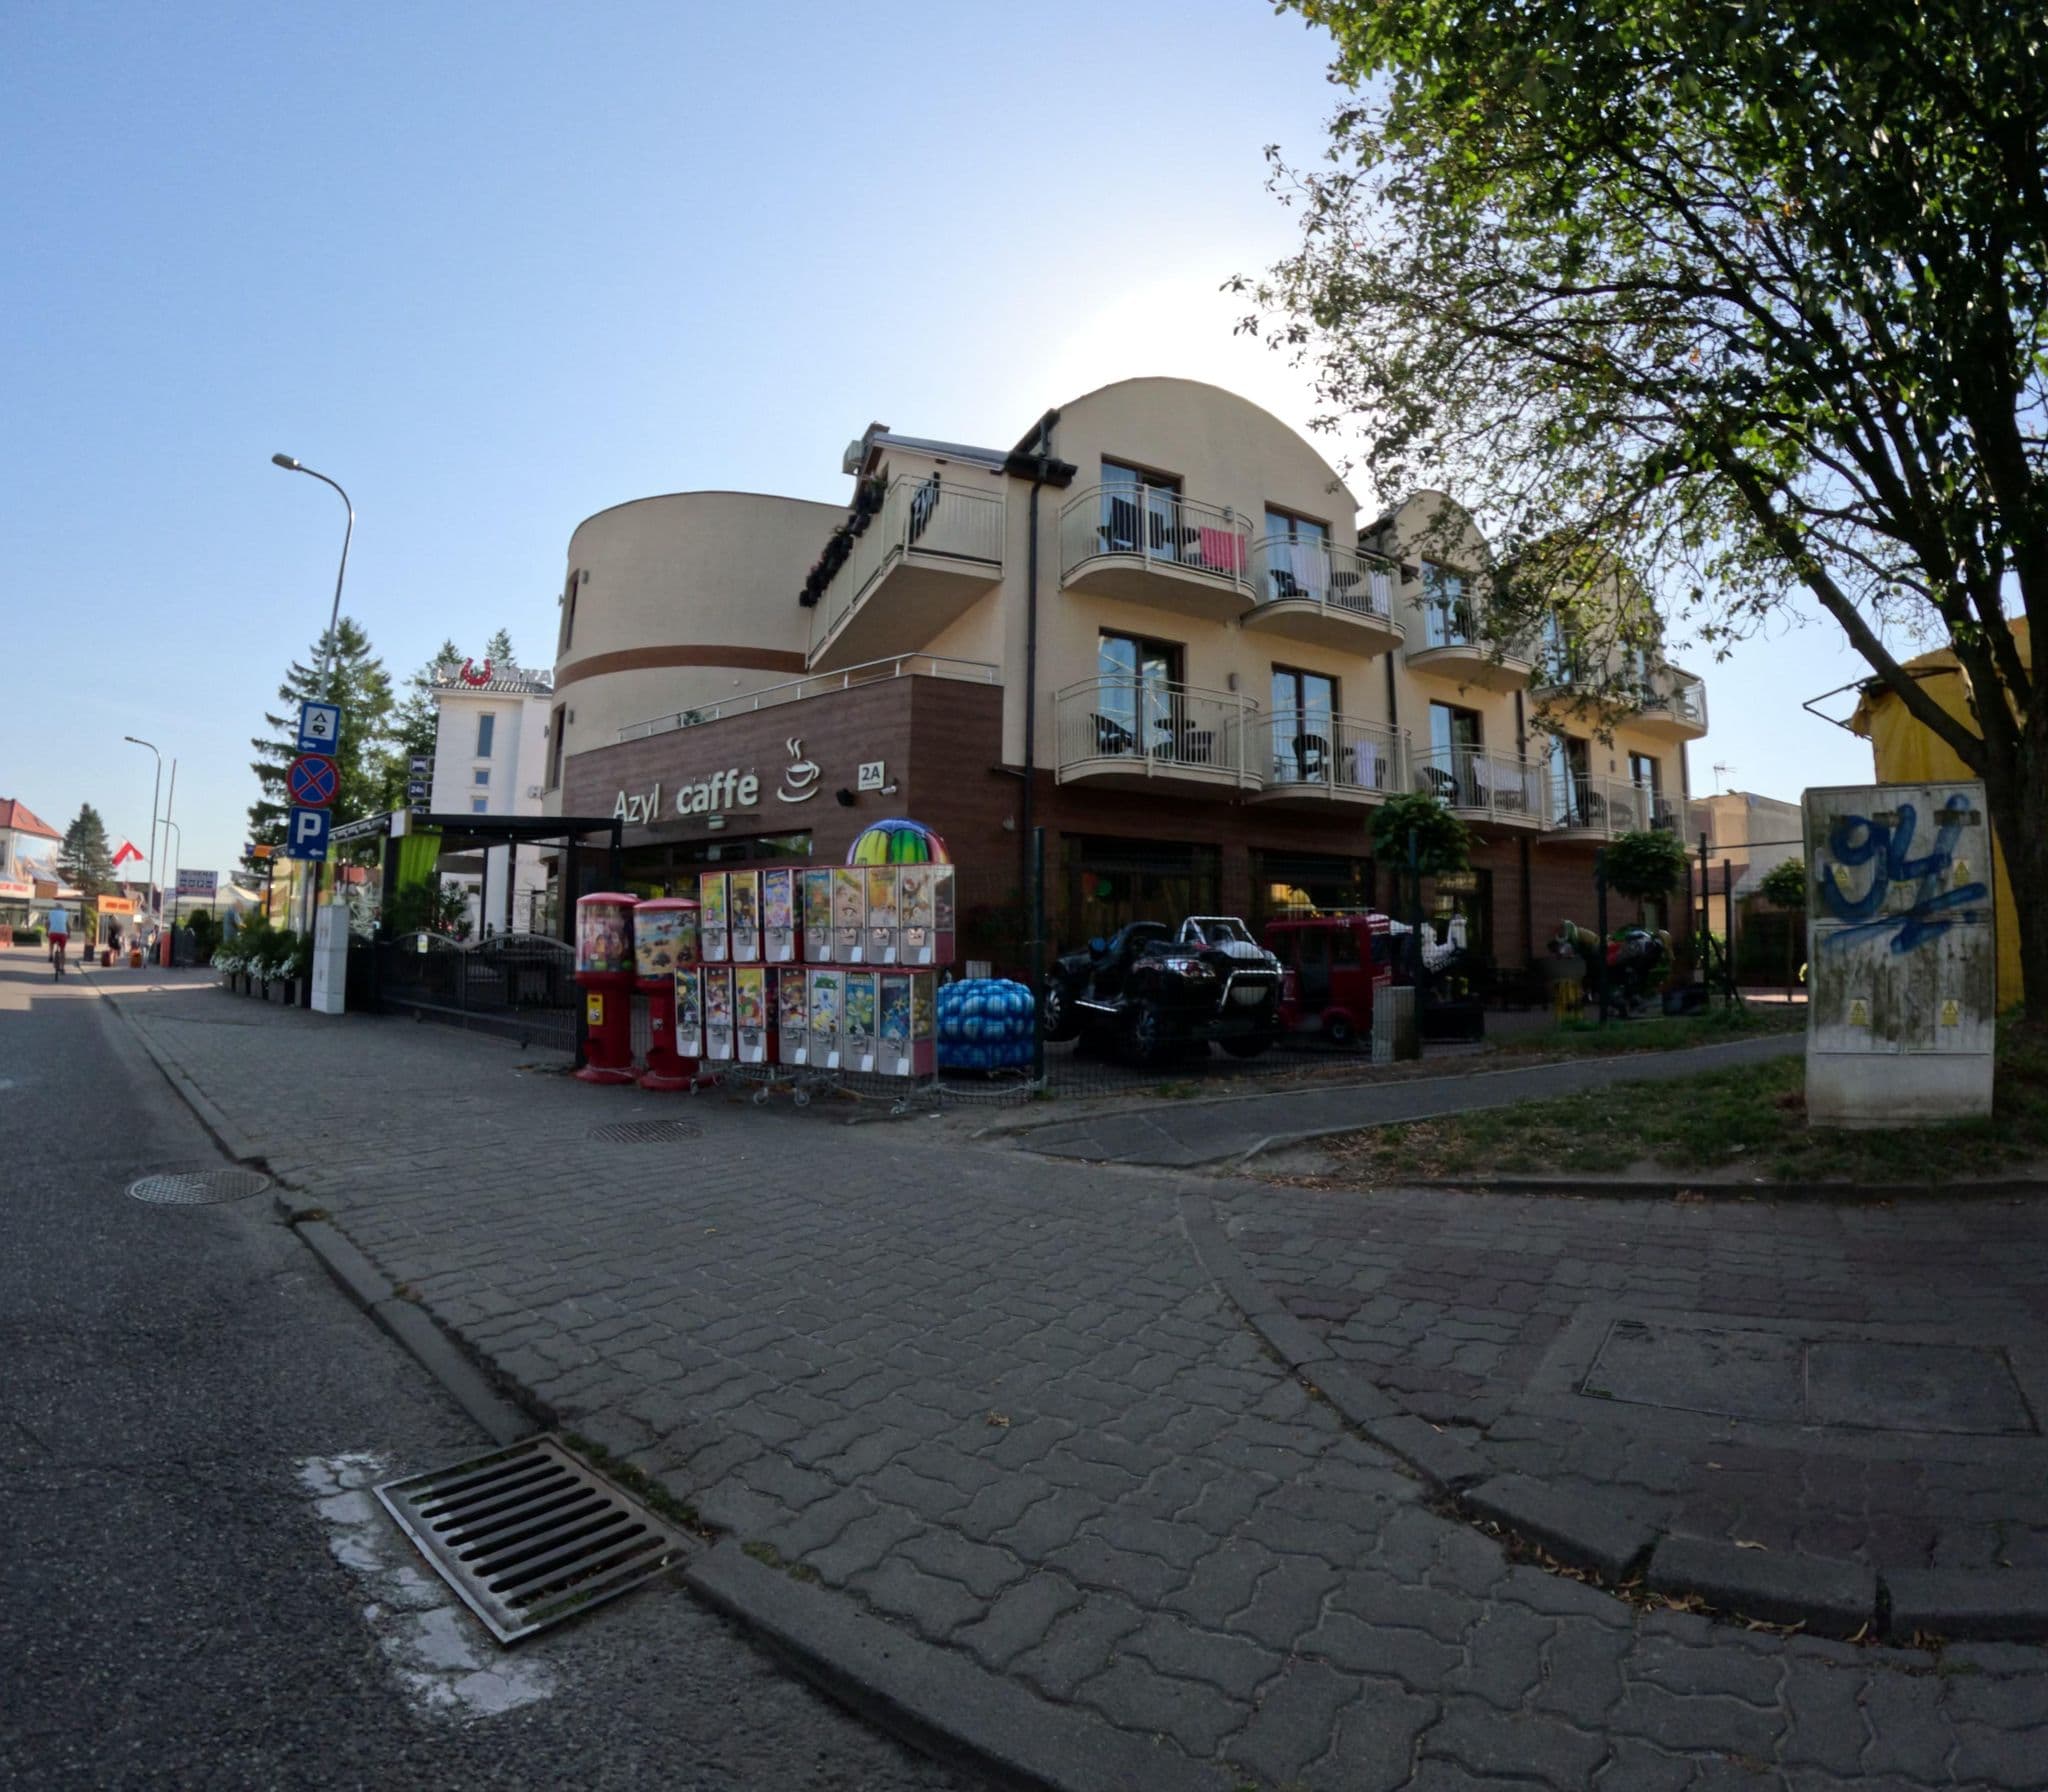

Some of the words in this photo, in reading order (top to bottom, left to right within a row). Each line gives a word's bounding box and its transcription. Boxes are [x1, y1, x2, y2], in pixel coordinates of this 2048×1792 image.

[861, 765, 881, 781] 2A
[613, 784, 661, 824] Azyl
[676, 769, 760, 814] caffe
[296, 811, 322, 844] P
